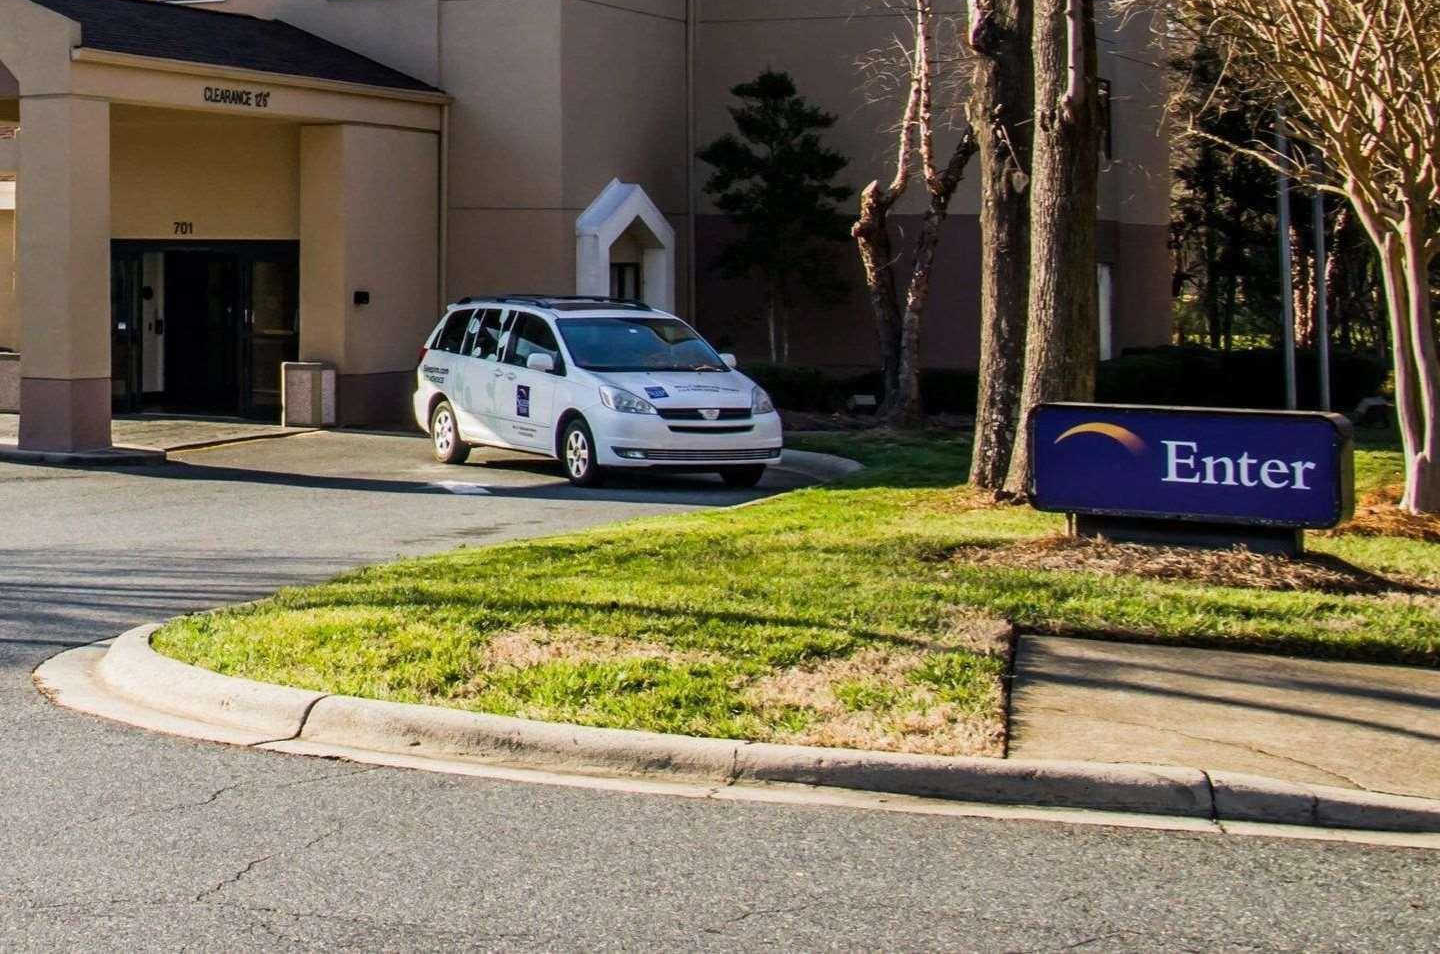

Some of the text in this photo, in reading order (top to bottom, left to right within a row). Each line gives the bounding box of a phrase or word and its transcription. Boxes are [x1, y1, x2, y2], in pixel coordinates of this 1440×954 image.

[203, 87, 252, 106] CLEARANCE
[173, 222, 193, 235] 701
[1160, 440, 1316, 490] Enter
